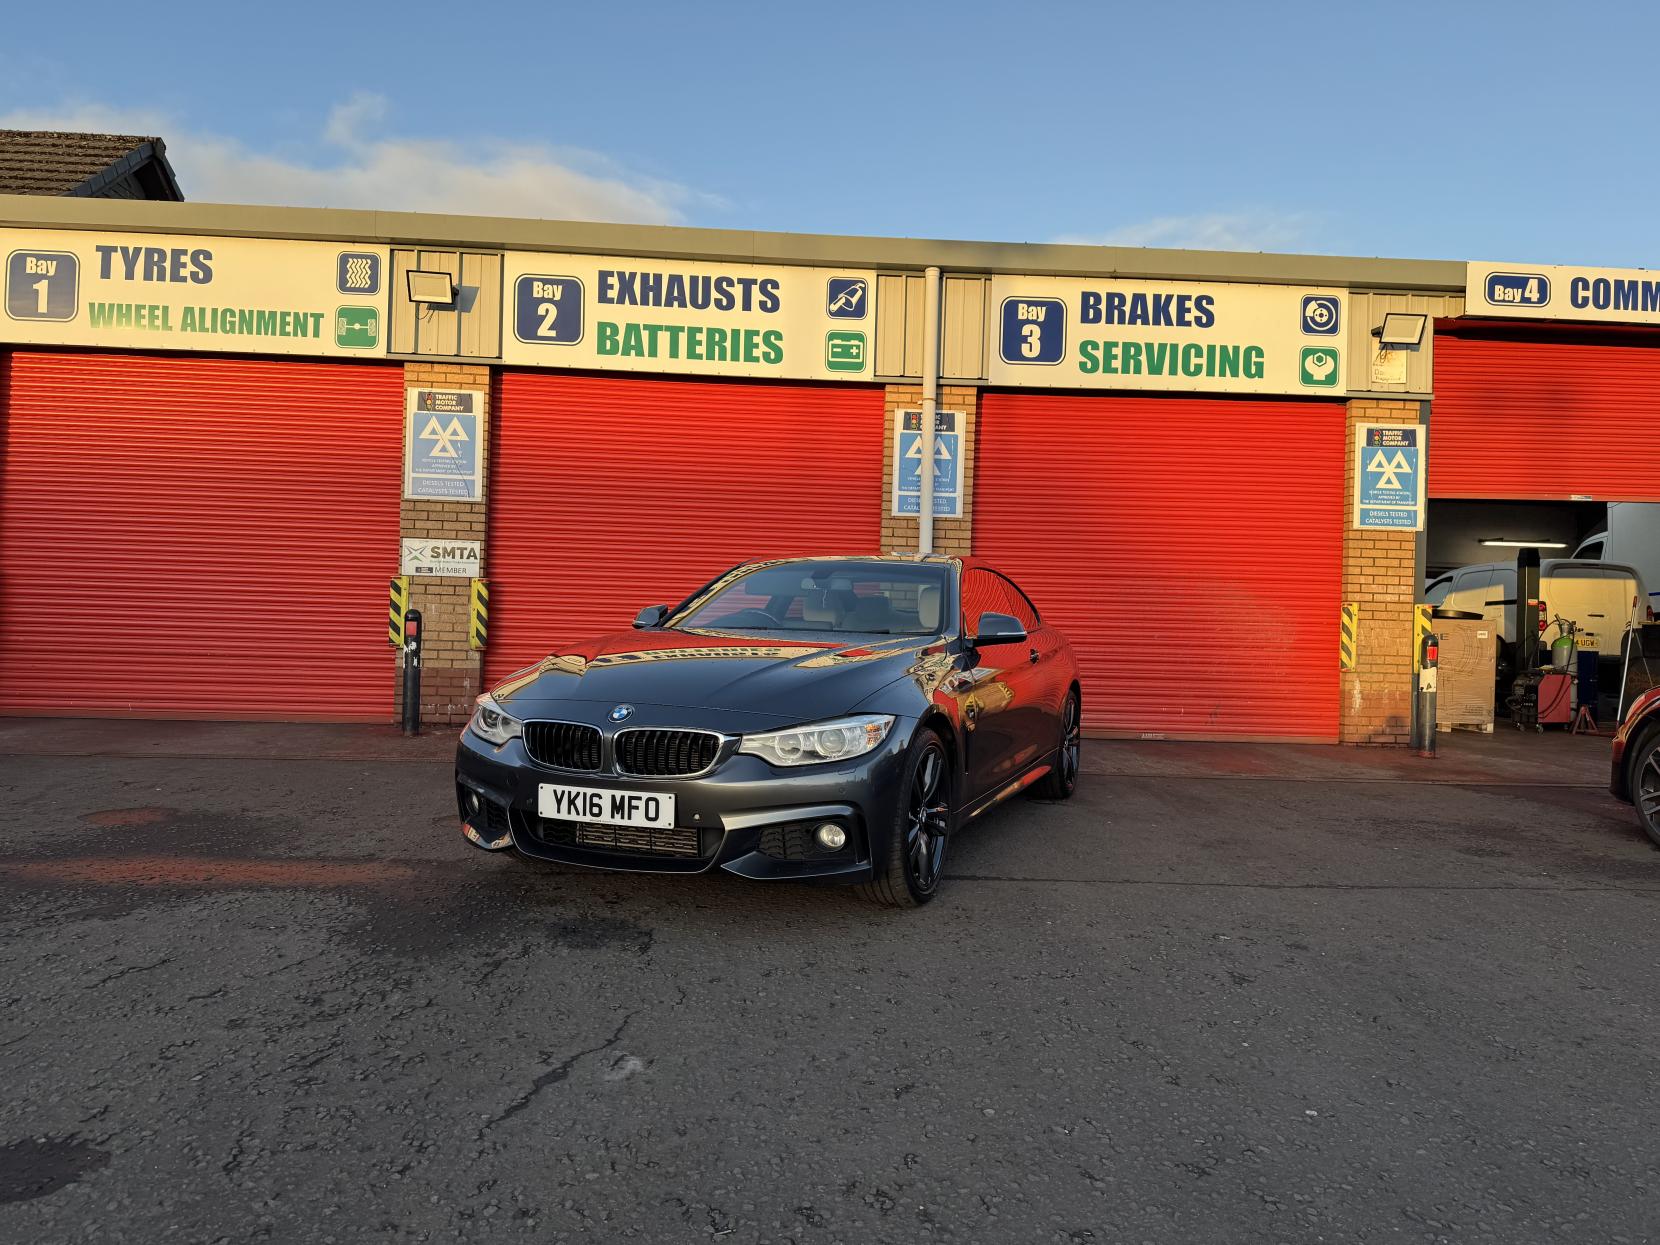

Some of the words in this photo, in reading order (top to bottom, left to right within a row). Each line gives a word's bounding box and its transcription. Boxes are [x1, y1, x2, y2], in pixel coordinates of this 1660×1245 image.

[25, 257, 57, 276] Bay
[95, 245, 214, 285] TYRES
[32, 279, 49, 314] 1
[532, 281, 563, 301] Bay
[597, 269, 781, 314] EXHAUSTS
[1494, 285, 1523, 303] Bay
[1524, 278, 1540, 302] 4
[1570, 276, 1660, 312] COMM
[88, 302, 174, 332] WHEEL
[180, 306, 325, 339] ALIGNMENT
[536, 303, 559, 338] 2
[1017, 303, 1047, 322] Bay
[1080, 291, 1216, 329] BRAKES
[596, 321, 784, 365] BATTERIES
[1021, 324, 1042, 358] 3
[1078, 340, 1265, 379] SERVICING
[430, 546, 479, 560] SMTA
[434, 566, 467, 574] MEMBER
[553, 789, 603, 818] YK16
[610, 794, 660, 822] MFO
